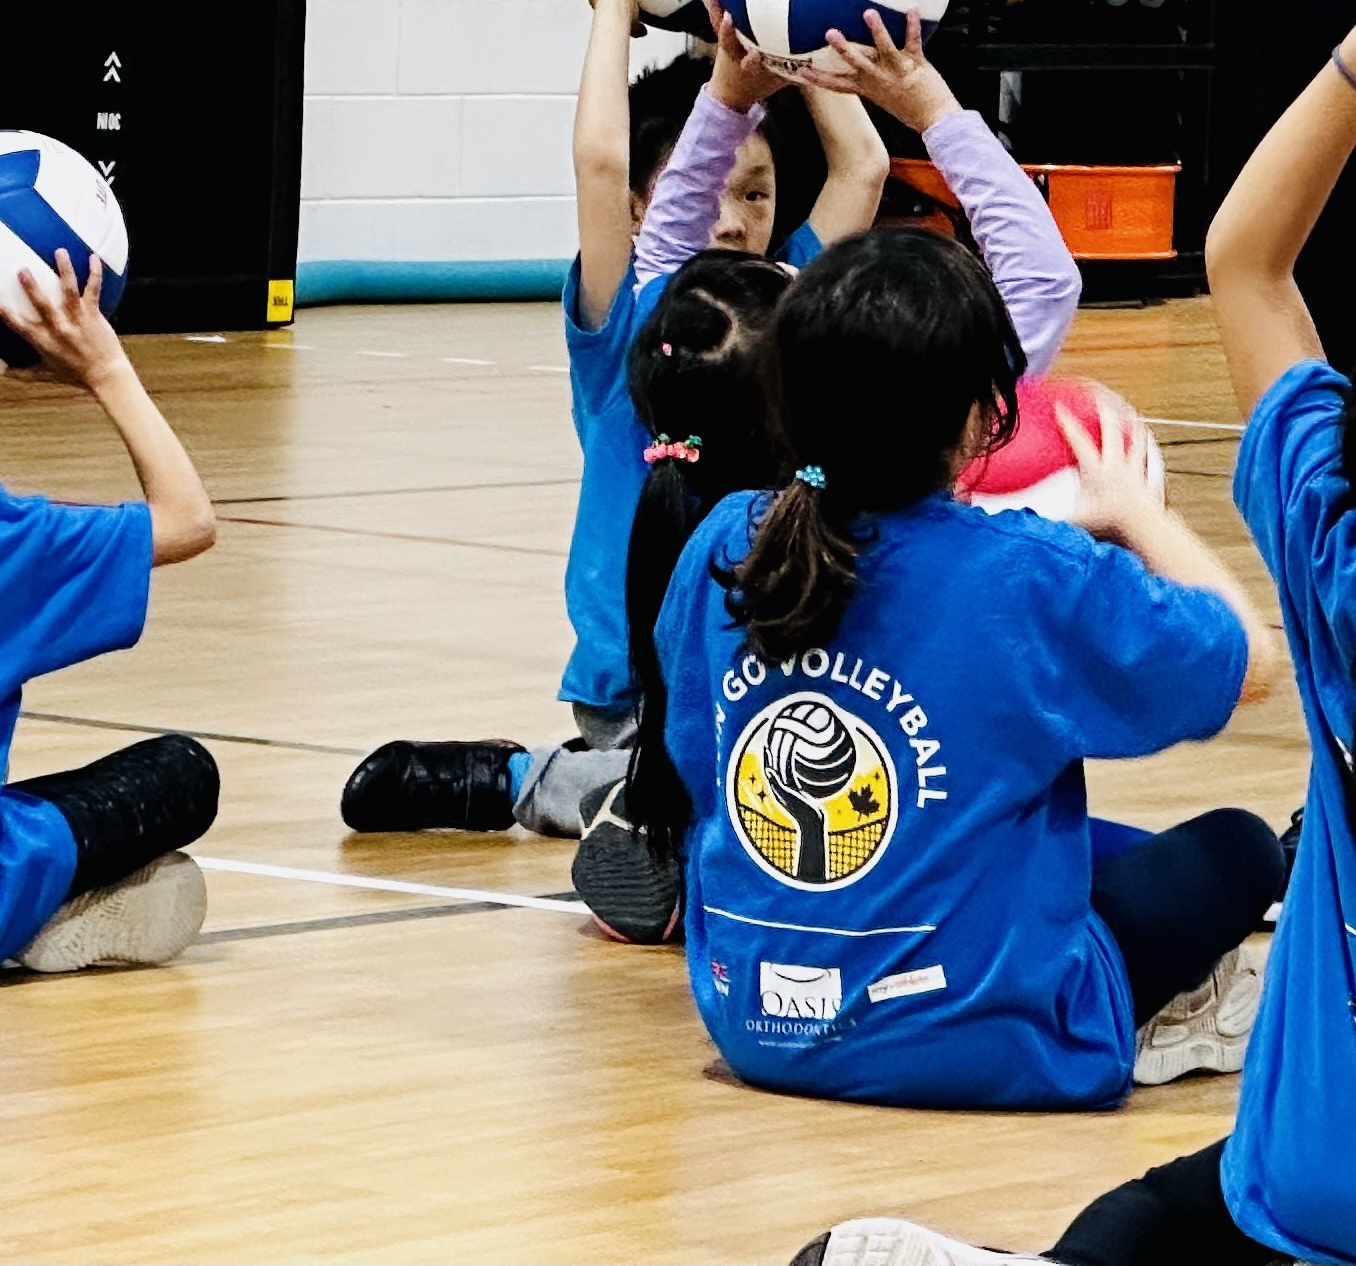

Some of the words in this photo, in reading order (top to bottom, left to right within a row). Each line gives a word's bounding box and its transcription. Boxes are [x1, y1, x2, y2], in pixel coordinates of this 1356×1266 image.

[722, 654, 767, 702] GO
[780, 647, 948, 809] VOLLEYBALL
[761, 990, 842, 1020] OASIS
